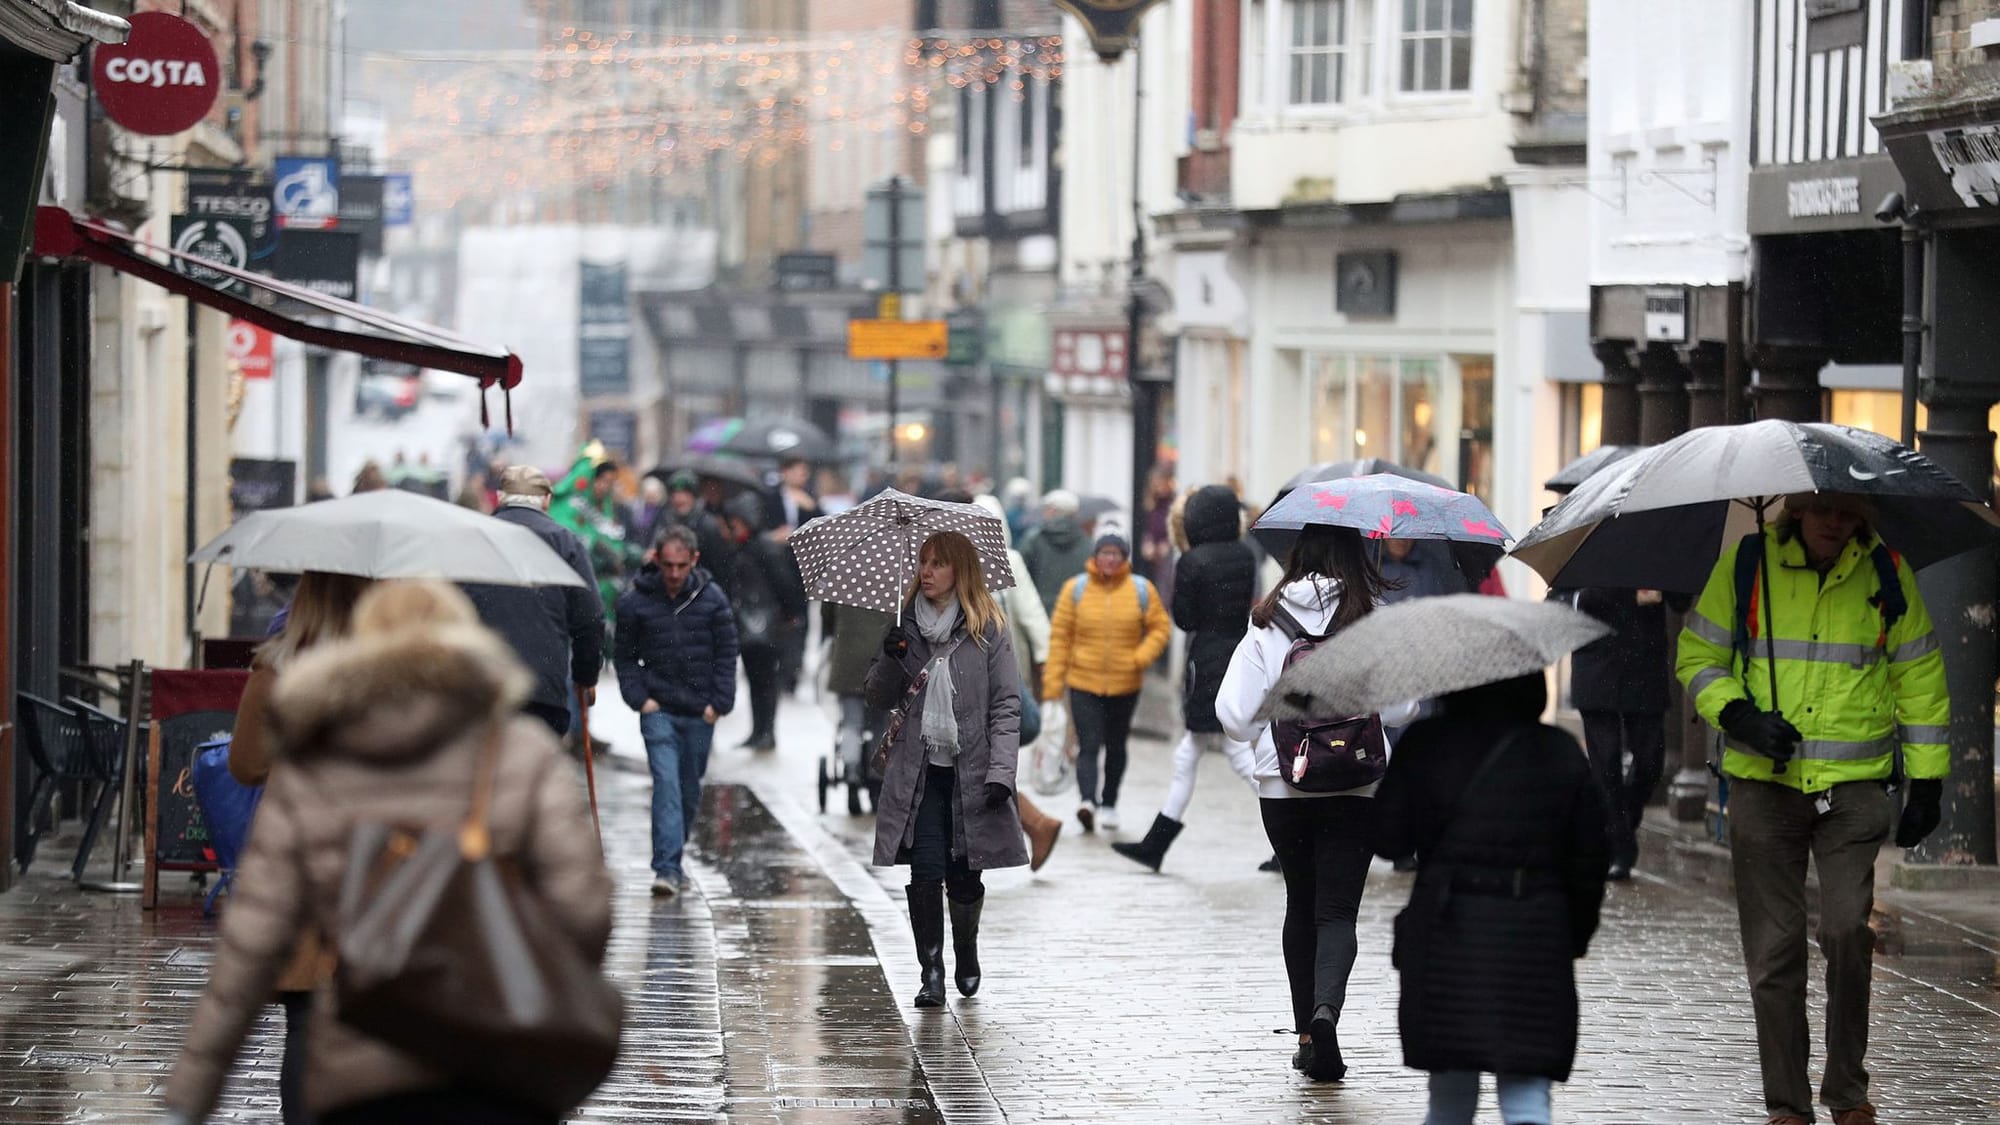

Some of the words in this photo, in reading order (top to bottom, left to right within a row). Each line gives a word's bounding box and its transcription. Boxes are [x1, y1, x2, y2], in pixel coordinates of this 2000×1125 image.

[105, 57, 206, 88] COSTA
[193, 196, 271, 216] TESCO
[198, 241, 224, 256] THE
[190, 264, 227, 280] SHO
